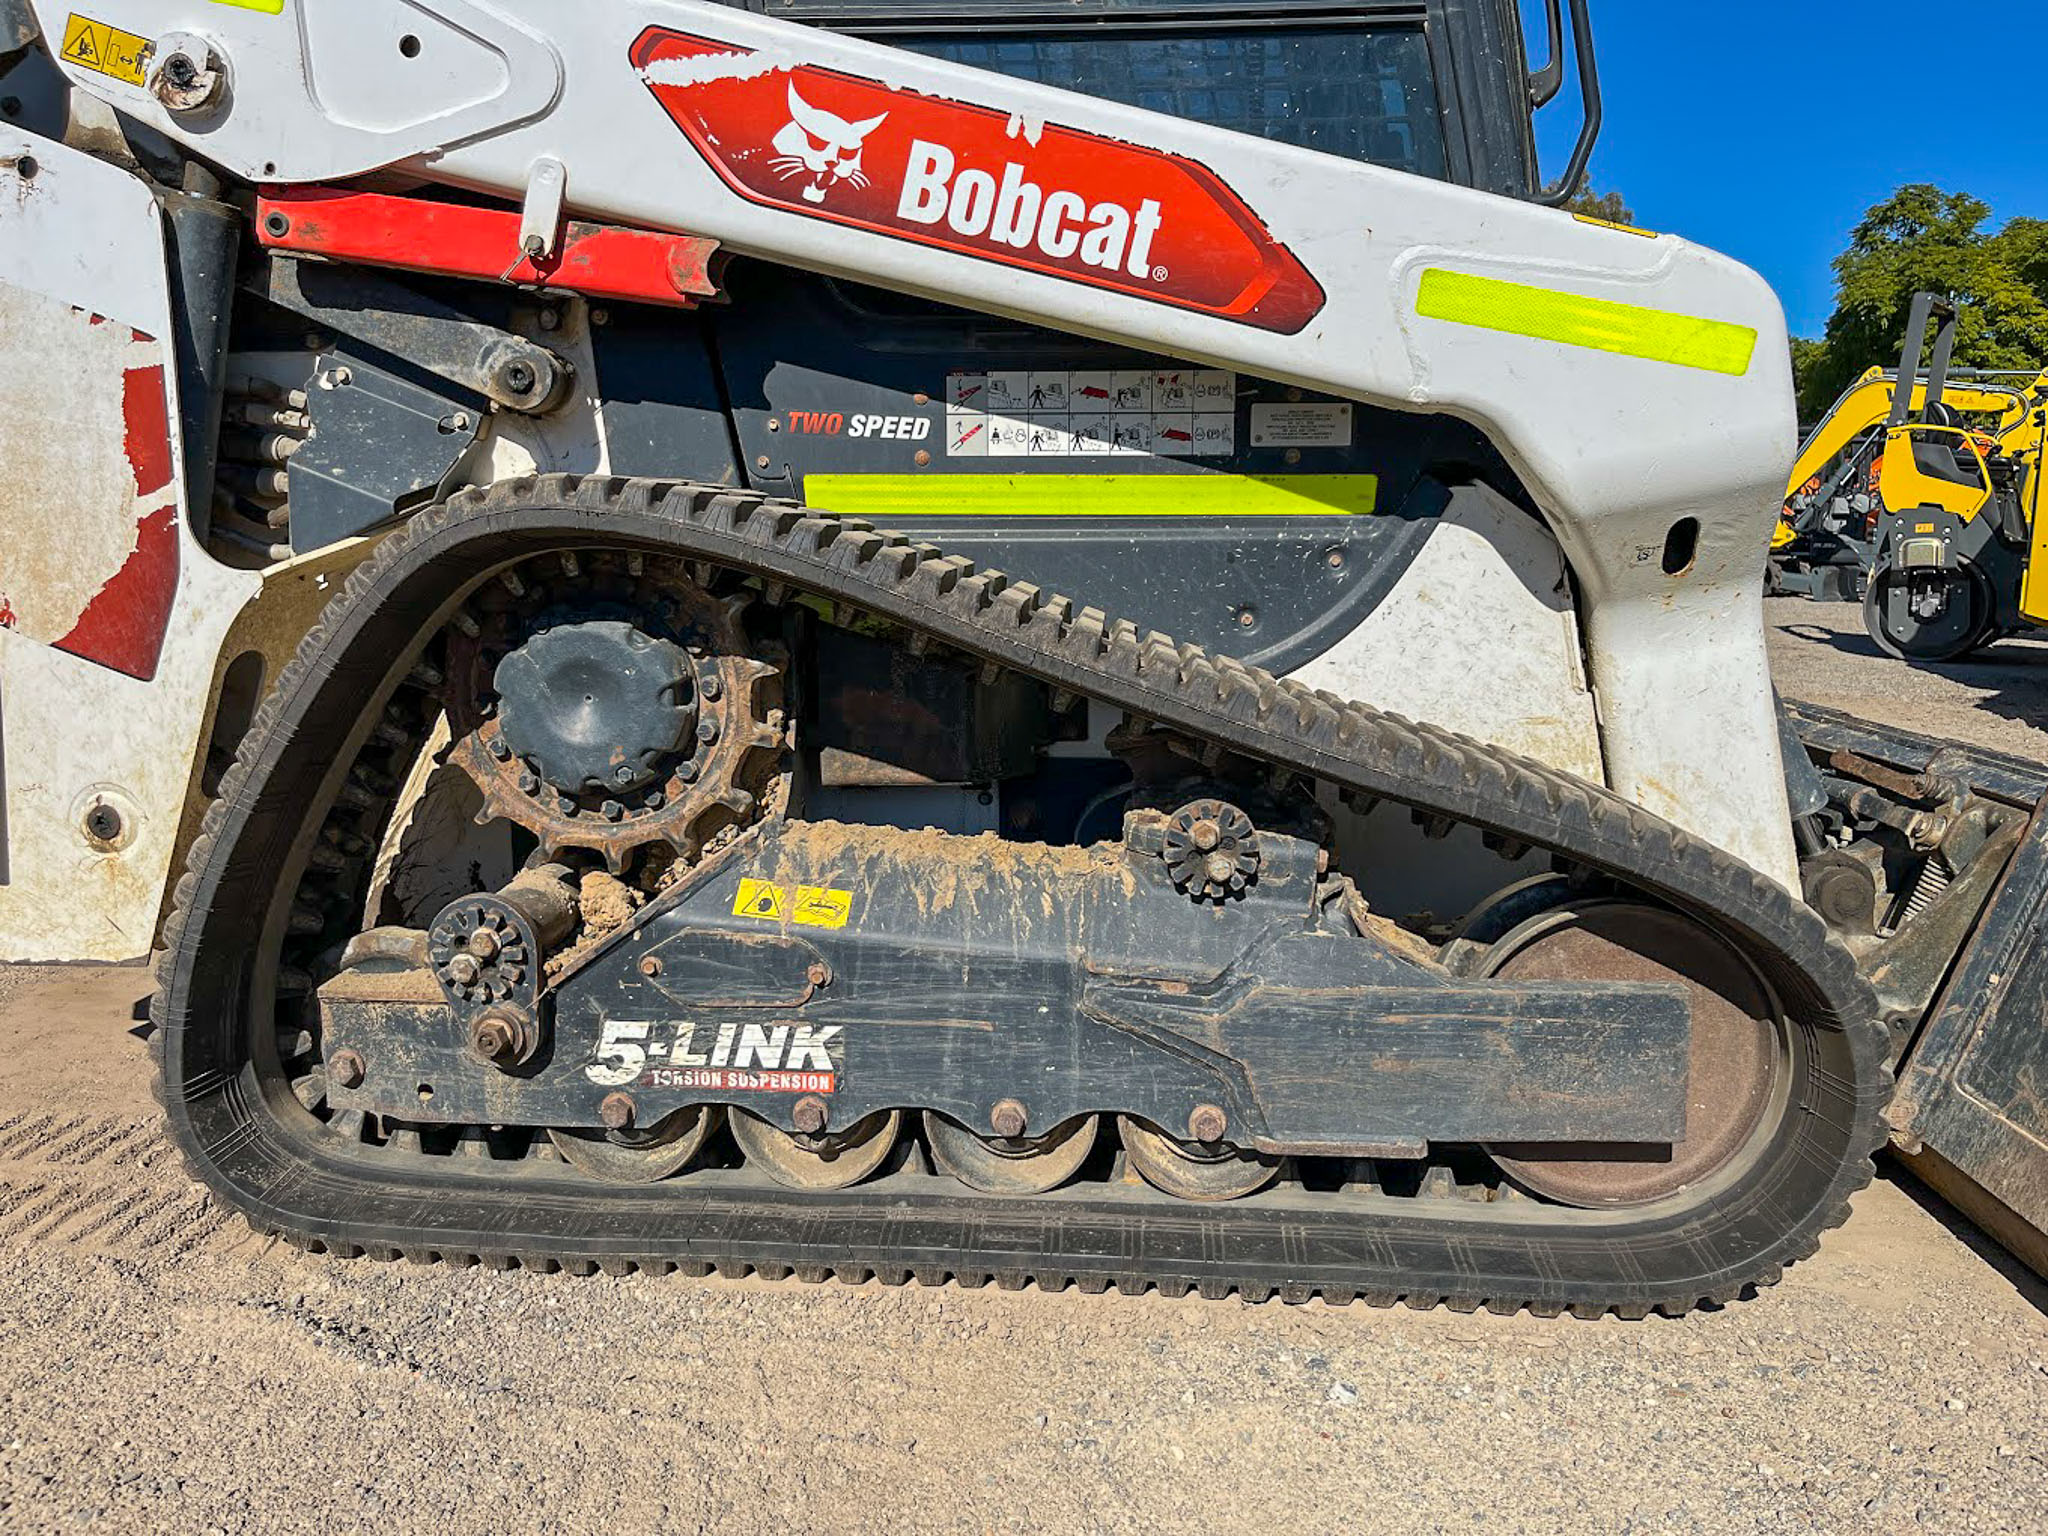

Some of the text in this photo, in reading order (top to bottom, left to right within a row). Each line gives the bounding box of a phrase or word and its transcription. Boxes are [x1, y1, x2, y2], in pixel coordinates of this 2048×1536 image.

[788, 411, 931, 441] TWO SPEED
[585, 1020, 844, 1086] 5-LINK
[651, 1070, 830, 1090] TORSION SUSPENSION
